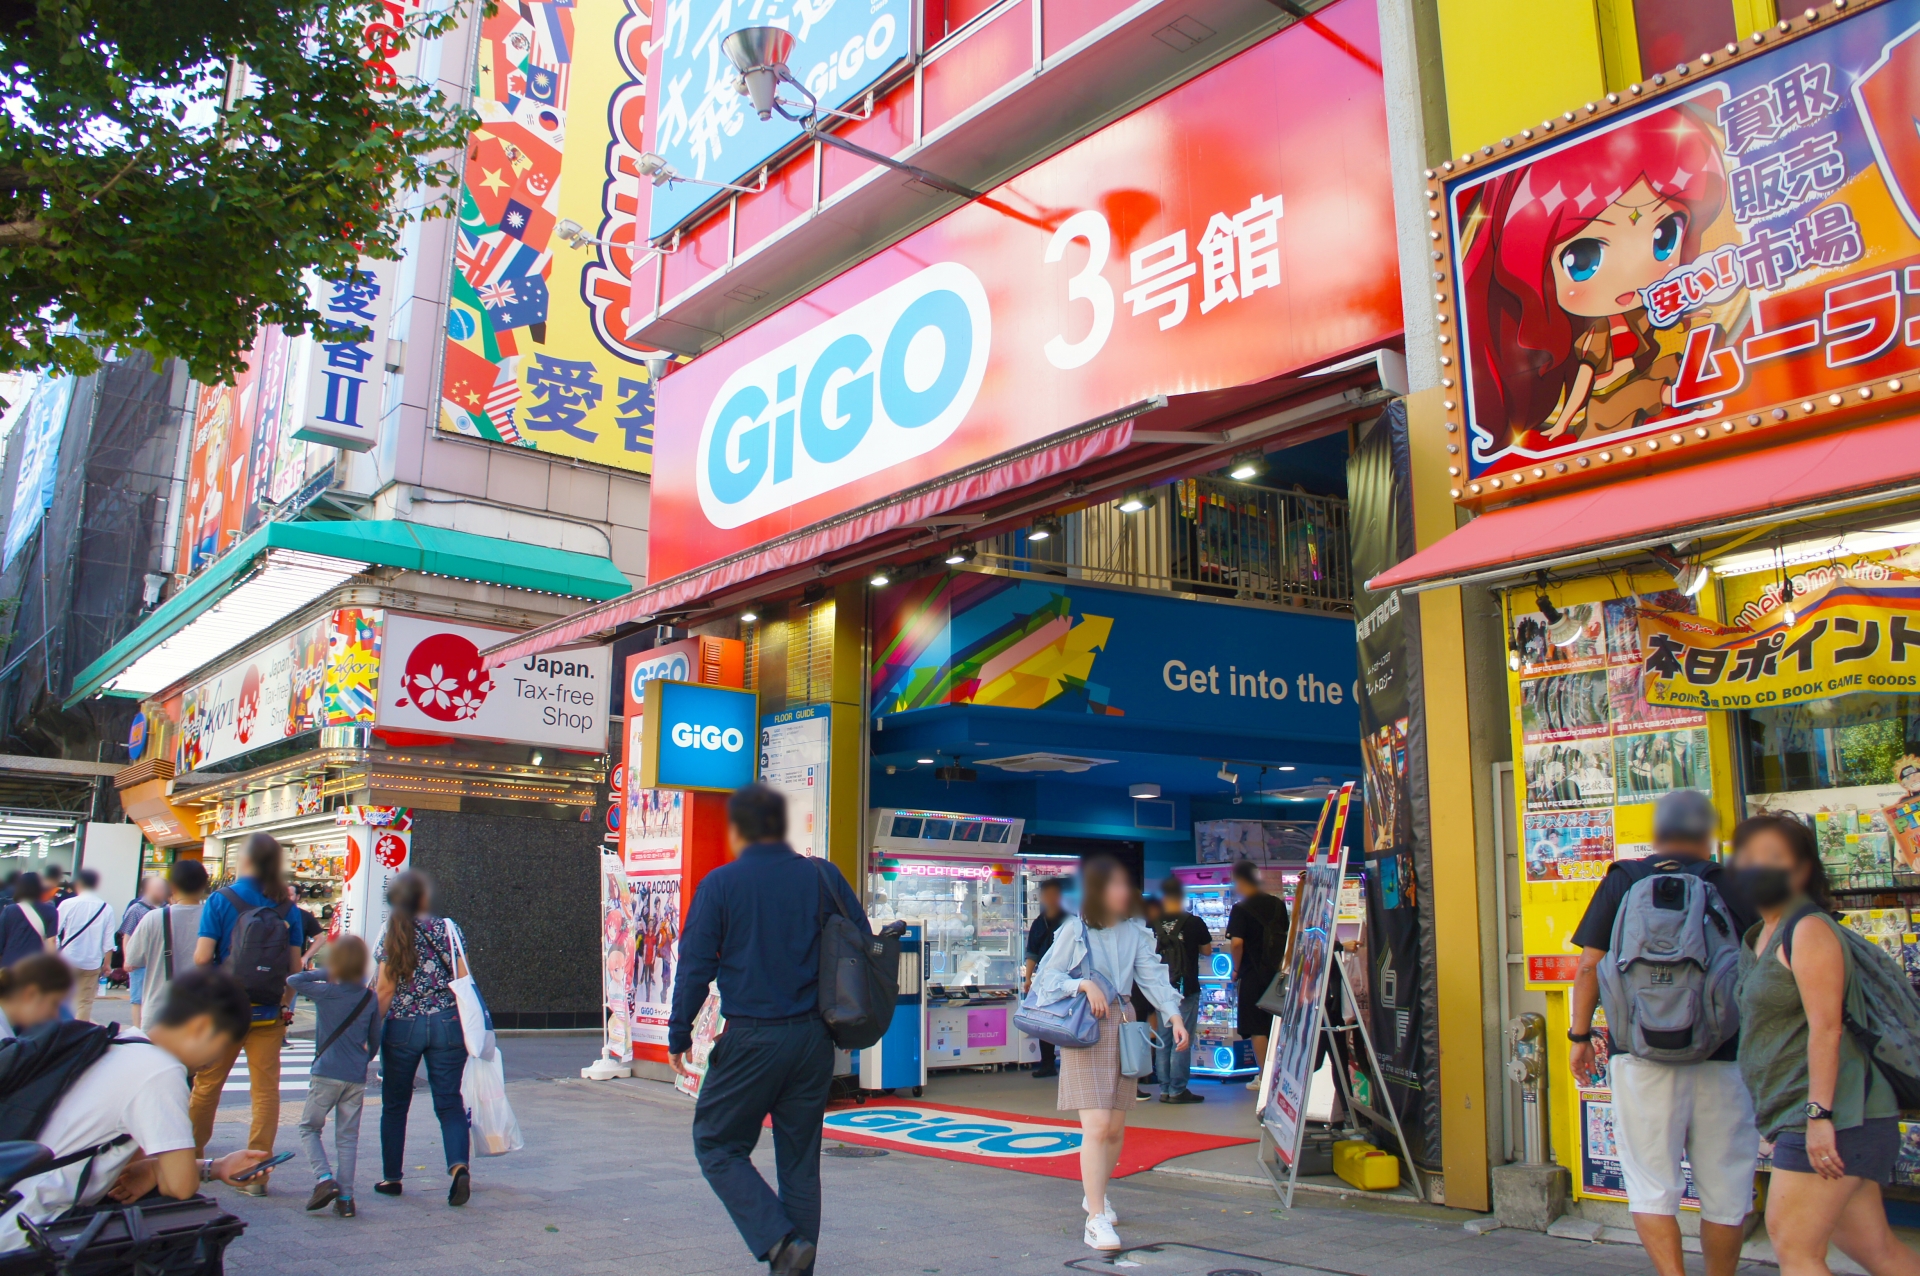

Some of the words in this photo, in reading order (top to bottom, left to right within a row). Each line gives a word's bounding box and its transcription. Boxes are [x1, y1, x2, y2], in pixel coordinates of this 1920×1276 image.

[804, 14, 896, 106] GiGO
[1717, 62, 1838, 157] 買取
[1731, 132, 1845, 224] 販売
[1736, 203, 1862, 290] 市場
[1043, 192, 1284, 371] 3号館
[707, 289, 973, 505] GiGO
[1852, 558, 1890, 582] to
[1645, 616, 1920, 685] 本日ポイント
[524, 655, 595, 680] Japan.
[1163, 659, 1220, 695] Get
[1229, 664, 1288, 700] into
[1299, 671, 1343, 705] the
[514, 678, 594, 706] Tax-free
[1722, 694, 1751, 706] DVD
[1755, 690, 1777, 704] CD
[1782, 678, 1823, 699] BOOK
[1828, 674, 1863, 690] GAME
[1868, 675, 1917, 686] GOODS
[543, 706, 593, 734] Shop
[774, 712, 793, 724] FLOOR
[796, 708, 815, 719] GUIDE
[671, 722, 744, 752] GiGO
[900, 866, 926, 876] UFO
[1535, 957, 1579, 968] 連結送水
[641, 1006, 654, 1016] GiGO
[823, 1109, 1084, 1154] GiGO
